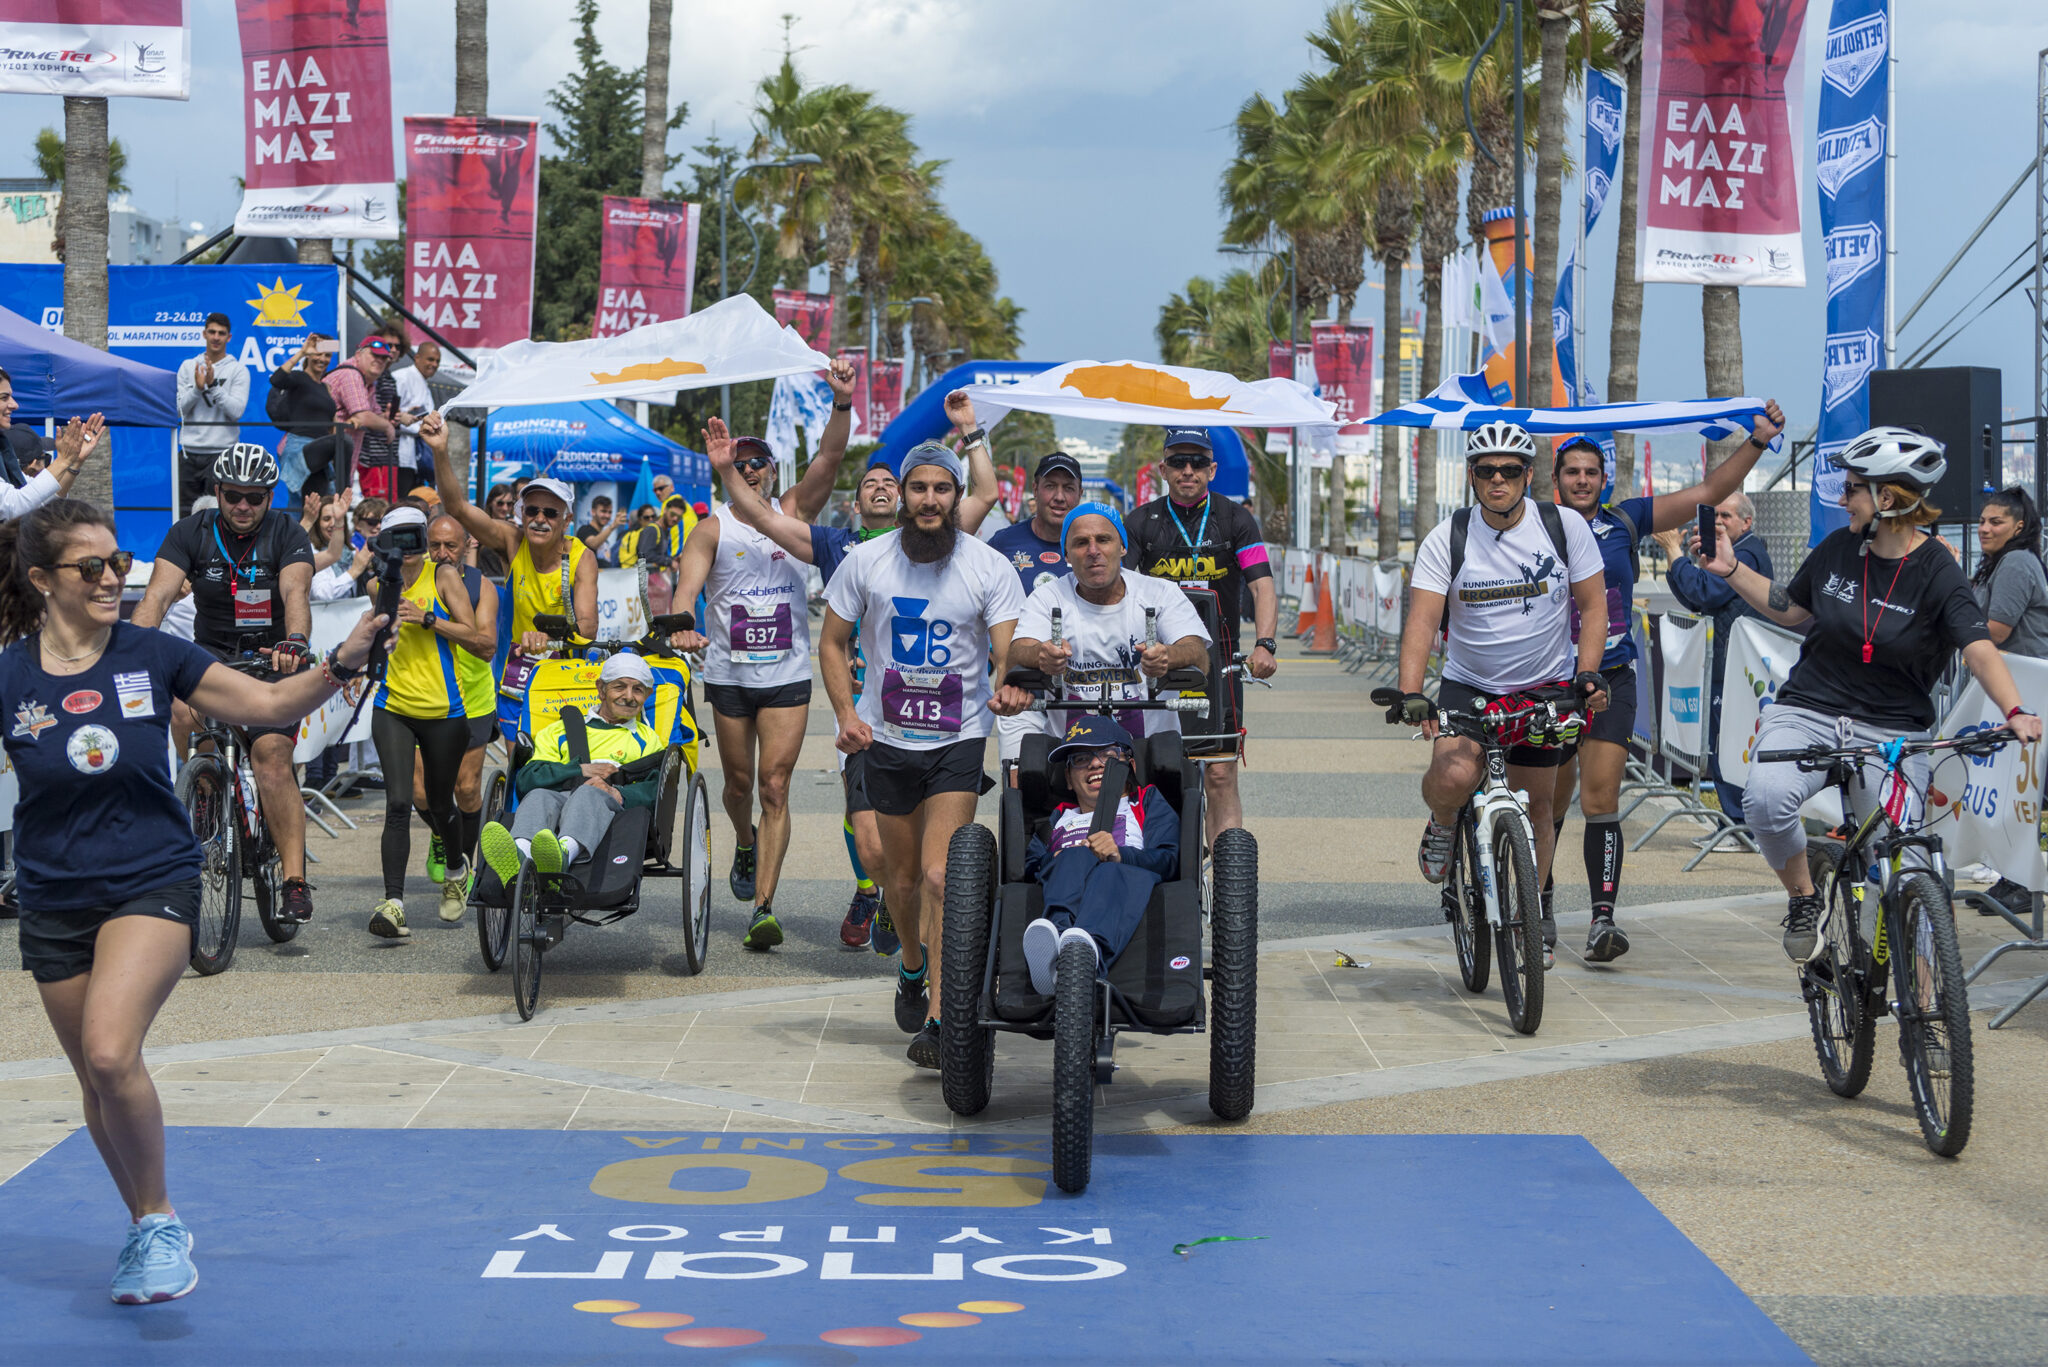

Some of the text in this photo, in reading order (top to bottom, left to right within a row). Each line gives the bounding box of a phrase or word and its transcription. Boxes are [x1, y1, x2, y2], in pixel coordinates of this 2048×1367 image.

[253, 56, 327, 92] ΕΛΑ
[255, 92, 352, 128] ΜΑΖΙ
[1667, 100, 1746, 135] ΕΛΑ
[256, 130, 336, 165] ΜΑΣ
[1663, 137, 1767, 174] ΜΑΖΙ
[1659, 175, 1745, 210] ΜΑΣ
[413, 242, 480, 269] ΕΛΑ
[413, 273, 497, 299] ΜΑΖΙ
[413, 303, 481, 329] ΜΑΣ
[123, 332, 177, 341] MARATHON
[493, 418, 568, 432] ERDINGER
[556, 450, 609, 463] ERDINGER
[739, 582, 795, 597] cablenet
[1463, 578, 1505, 589] RUNNING
[1463, 586, 1535, 600] FROGMEN
[745, 627, 778, 644] 637
[900, 698, 942, 721] 413
[1062, 829, 1089, 839] MARATHON
[589, 1153, 1053, 1207] 50
[508, 1224, 1113, 1244] ΚΥΠΡΟΥ
